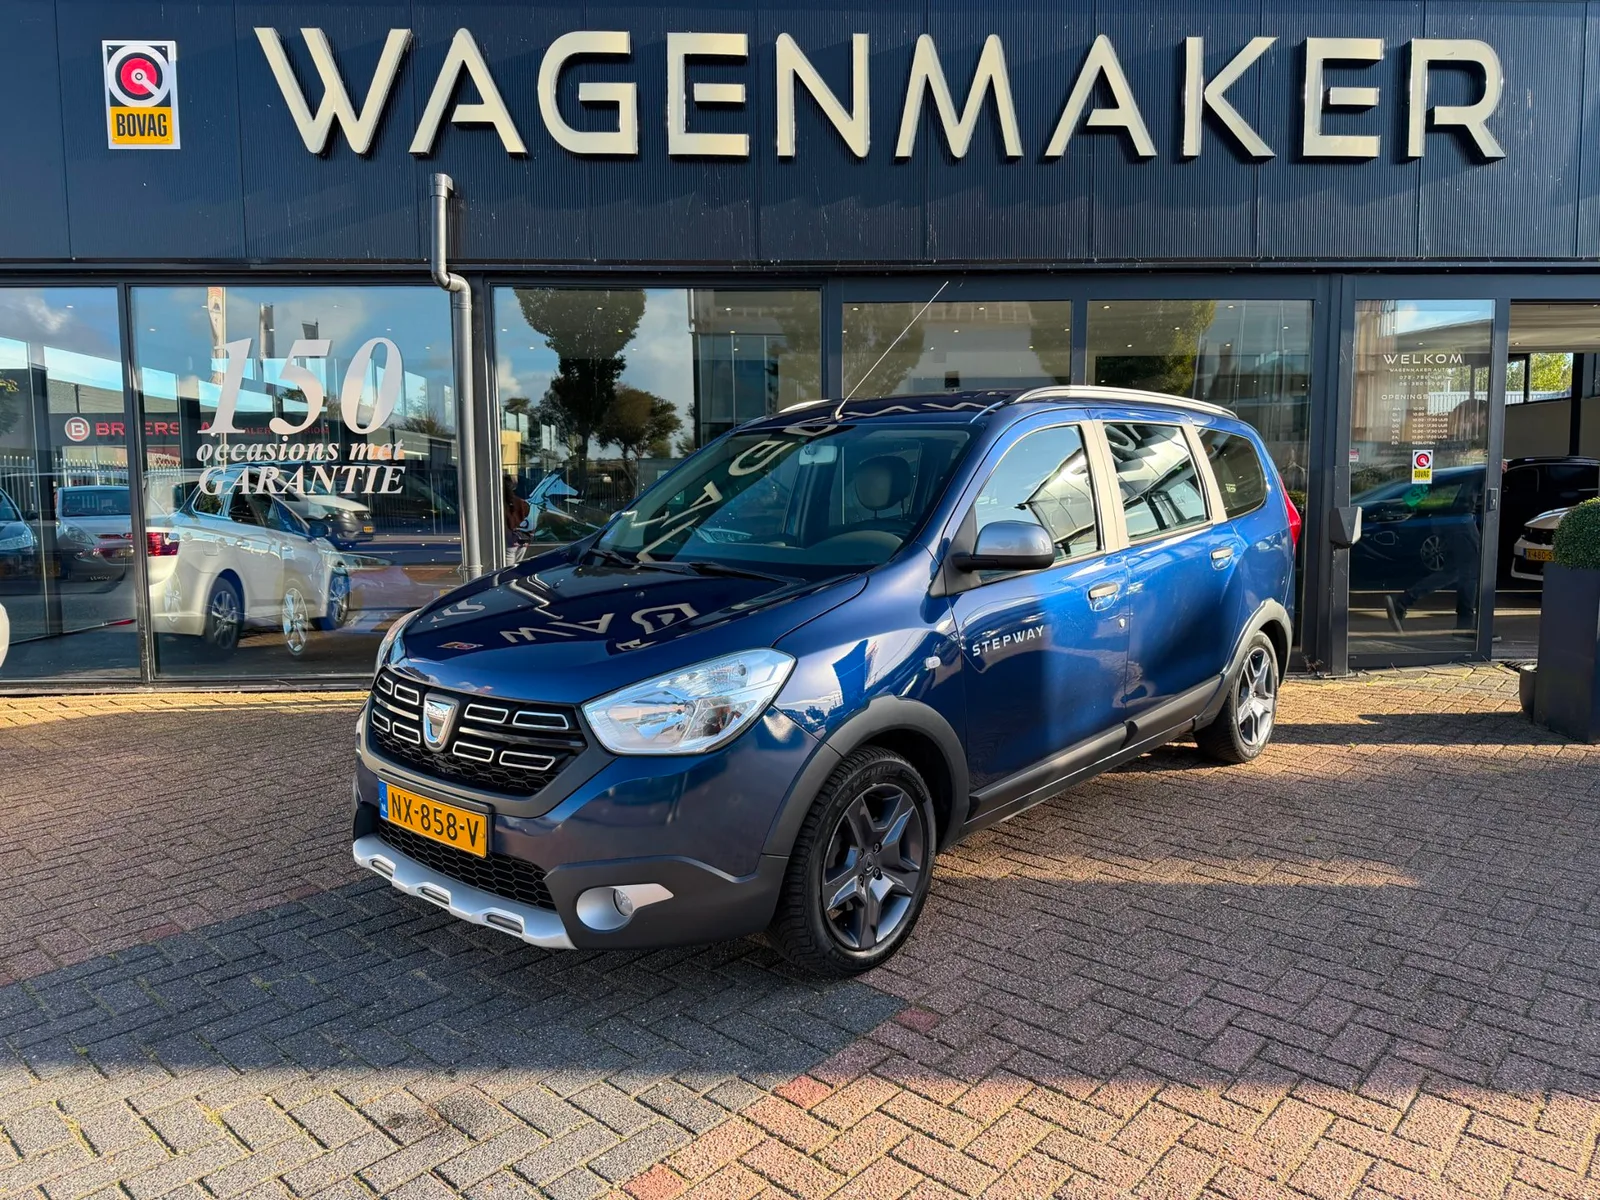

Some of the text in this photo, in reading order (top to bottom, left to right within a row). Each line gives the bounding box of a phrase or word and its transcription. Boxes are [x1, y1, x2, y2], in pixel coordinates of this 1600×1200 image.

[253, 26, 1507, 160] WAGENMAKER
[115, 112, 168, 138] BOVAG
[1383, 353, 1463, 365] WELKOM
[197, 336, 403, 435] 150
[95, 421, 180, 437] BRERS
[196, 434, 404, 463] occasions met
[199, 465, 406, 496] GARANTIE
[1414, 470, 1431, 478] BOVAG
[971, 625, 1045, 657] STEPWAY
[390, 791, 480, 848] NX-858-V
